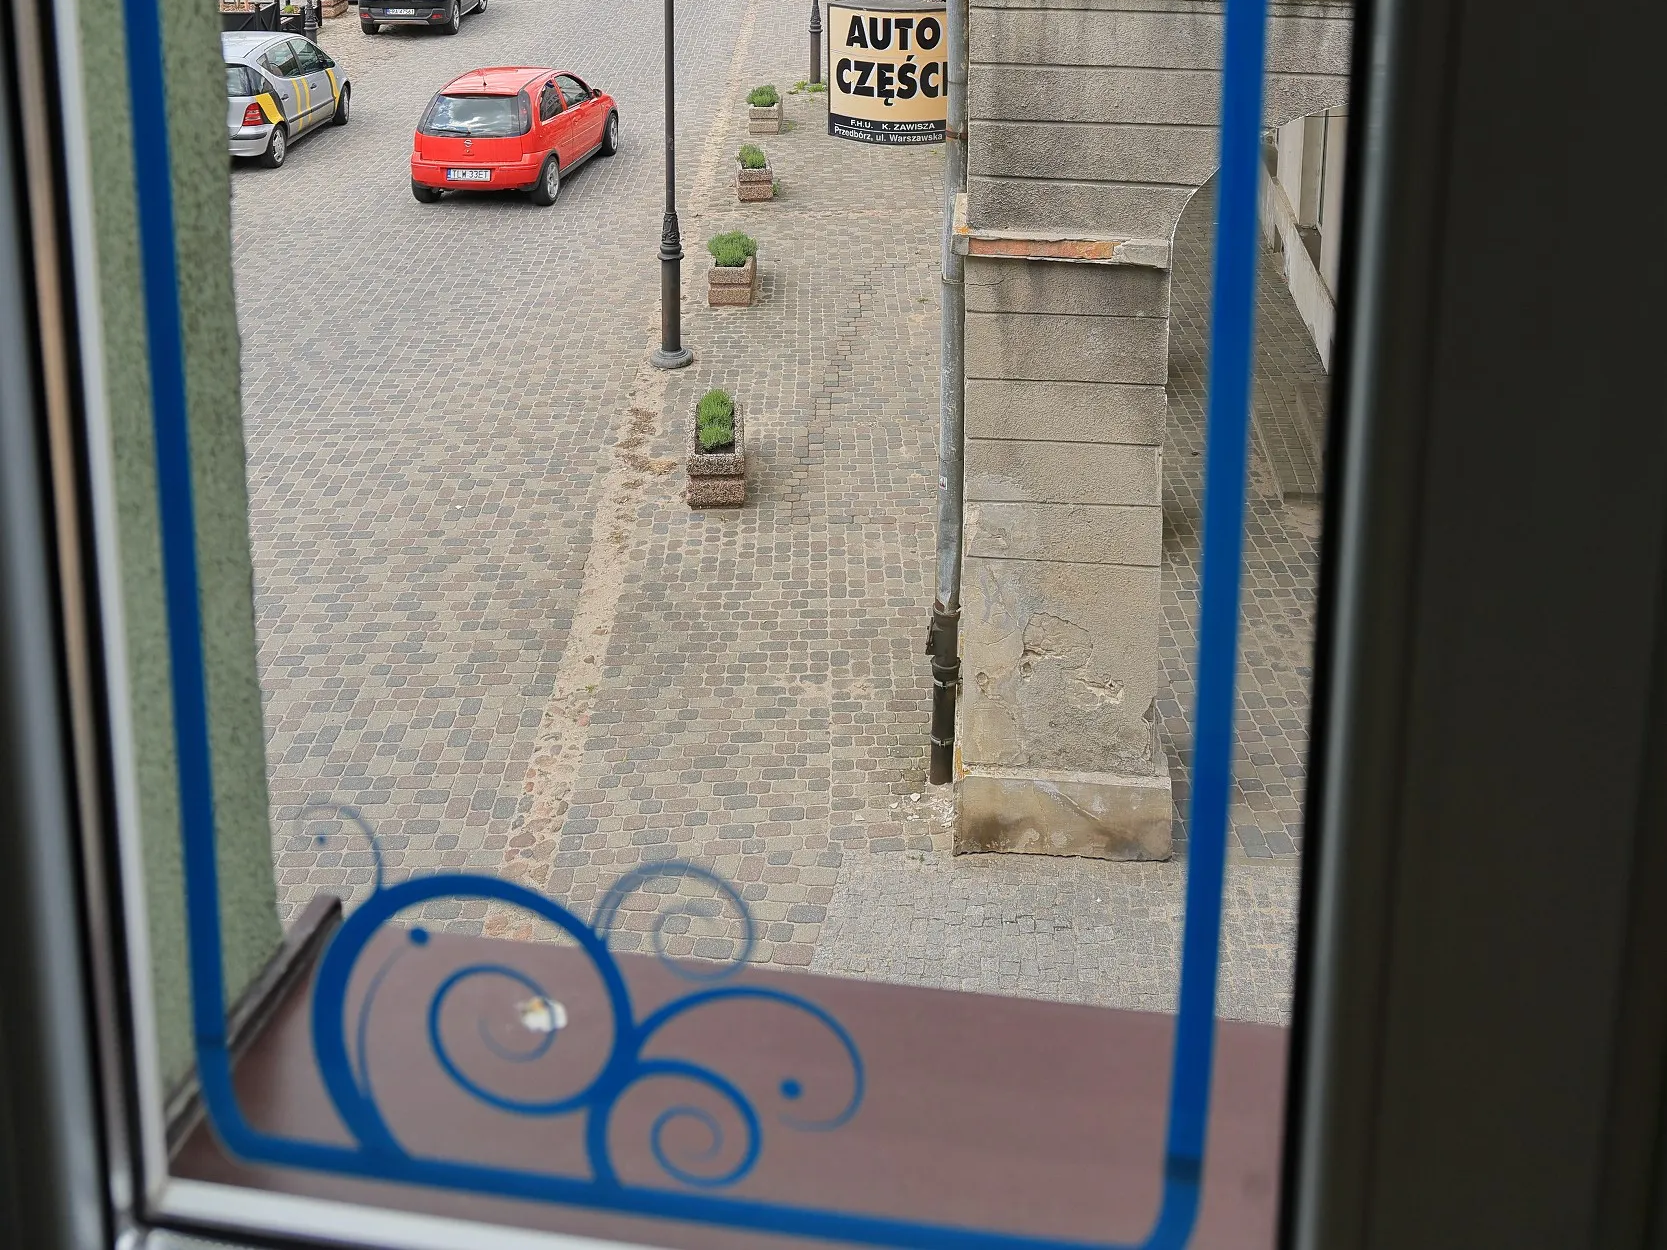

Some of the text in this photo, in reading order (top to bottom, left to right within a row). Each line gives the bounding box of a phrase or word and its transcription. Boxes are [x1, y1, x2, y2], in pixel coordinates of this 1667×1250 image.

[845, 15, 942, 50] AUTO
[850, 119, 936, 131] F.H.U. K. ZAWISZA
[834, 126, 943, 143] Przedbórz, ul. Warszawska
